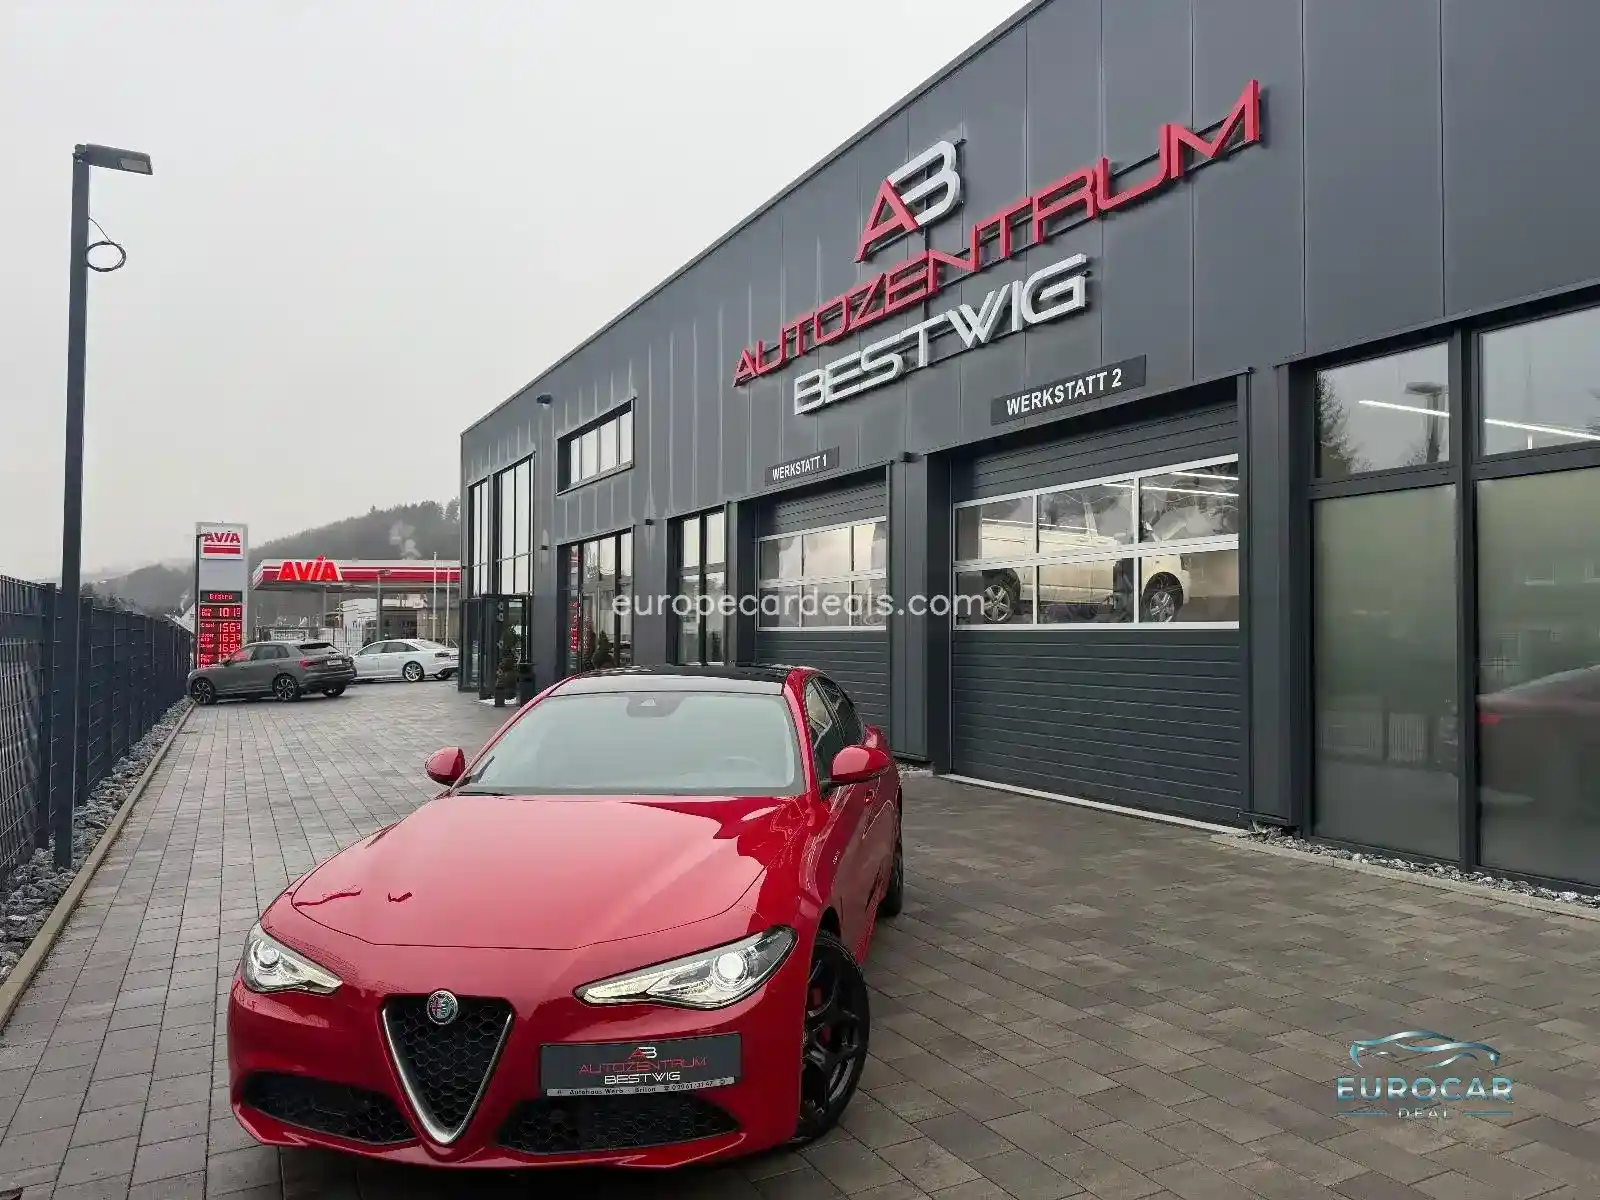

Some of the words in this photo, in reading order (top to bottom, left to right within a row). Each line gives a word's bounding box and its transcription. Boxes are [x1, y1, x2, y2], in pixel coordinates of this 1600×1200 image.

[733, 80, 1262, 388] AUTOZENTRUM
[794, 253, 1089, 415] BESTWIG
[1006, 371, 1108, 416] WERKSTATT
[1111, 367, 1122, 388] 2
[772, 455, 821, 481] WERKSTATT
[823, 453, 828, 467] 1
[203, 530, 241, 543] AVIA
[277, 553, 344, 582] AVIA
[579, 1055, 708, 1074] AUTOZENTRUM
[604, 1071, 681, 1085] BESTWIG
